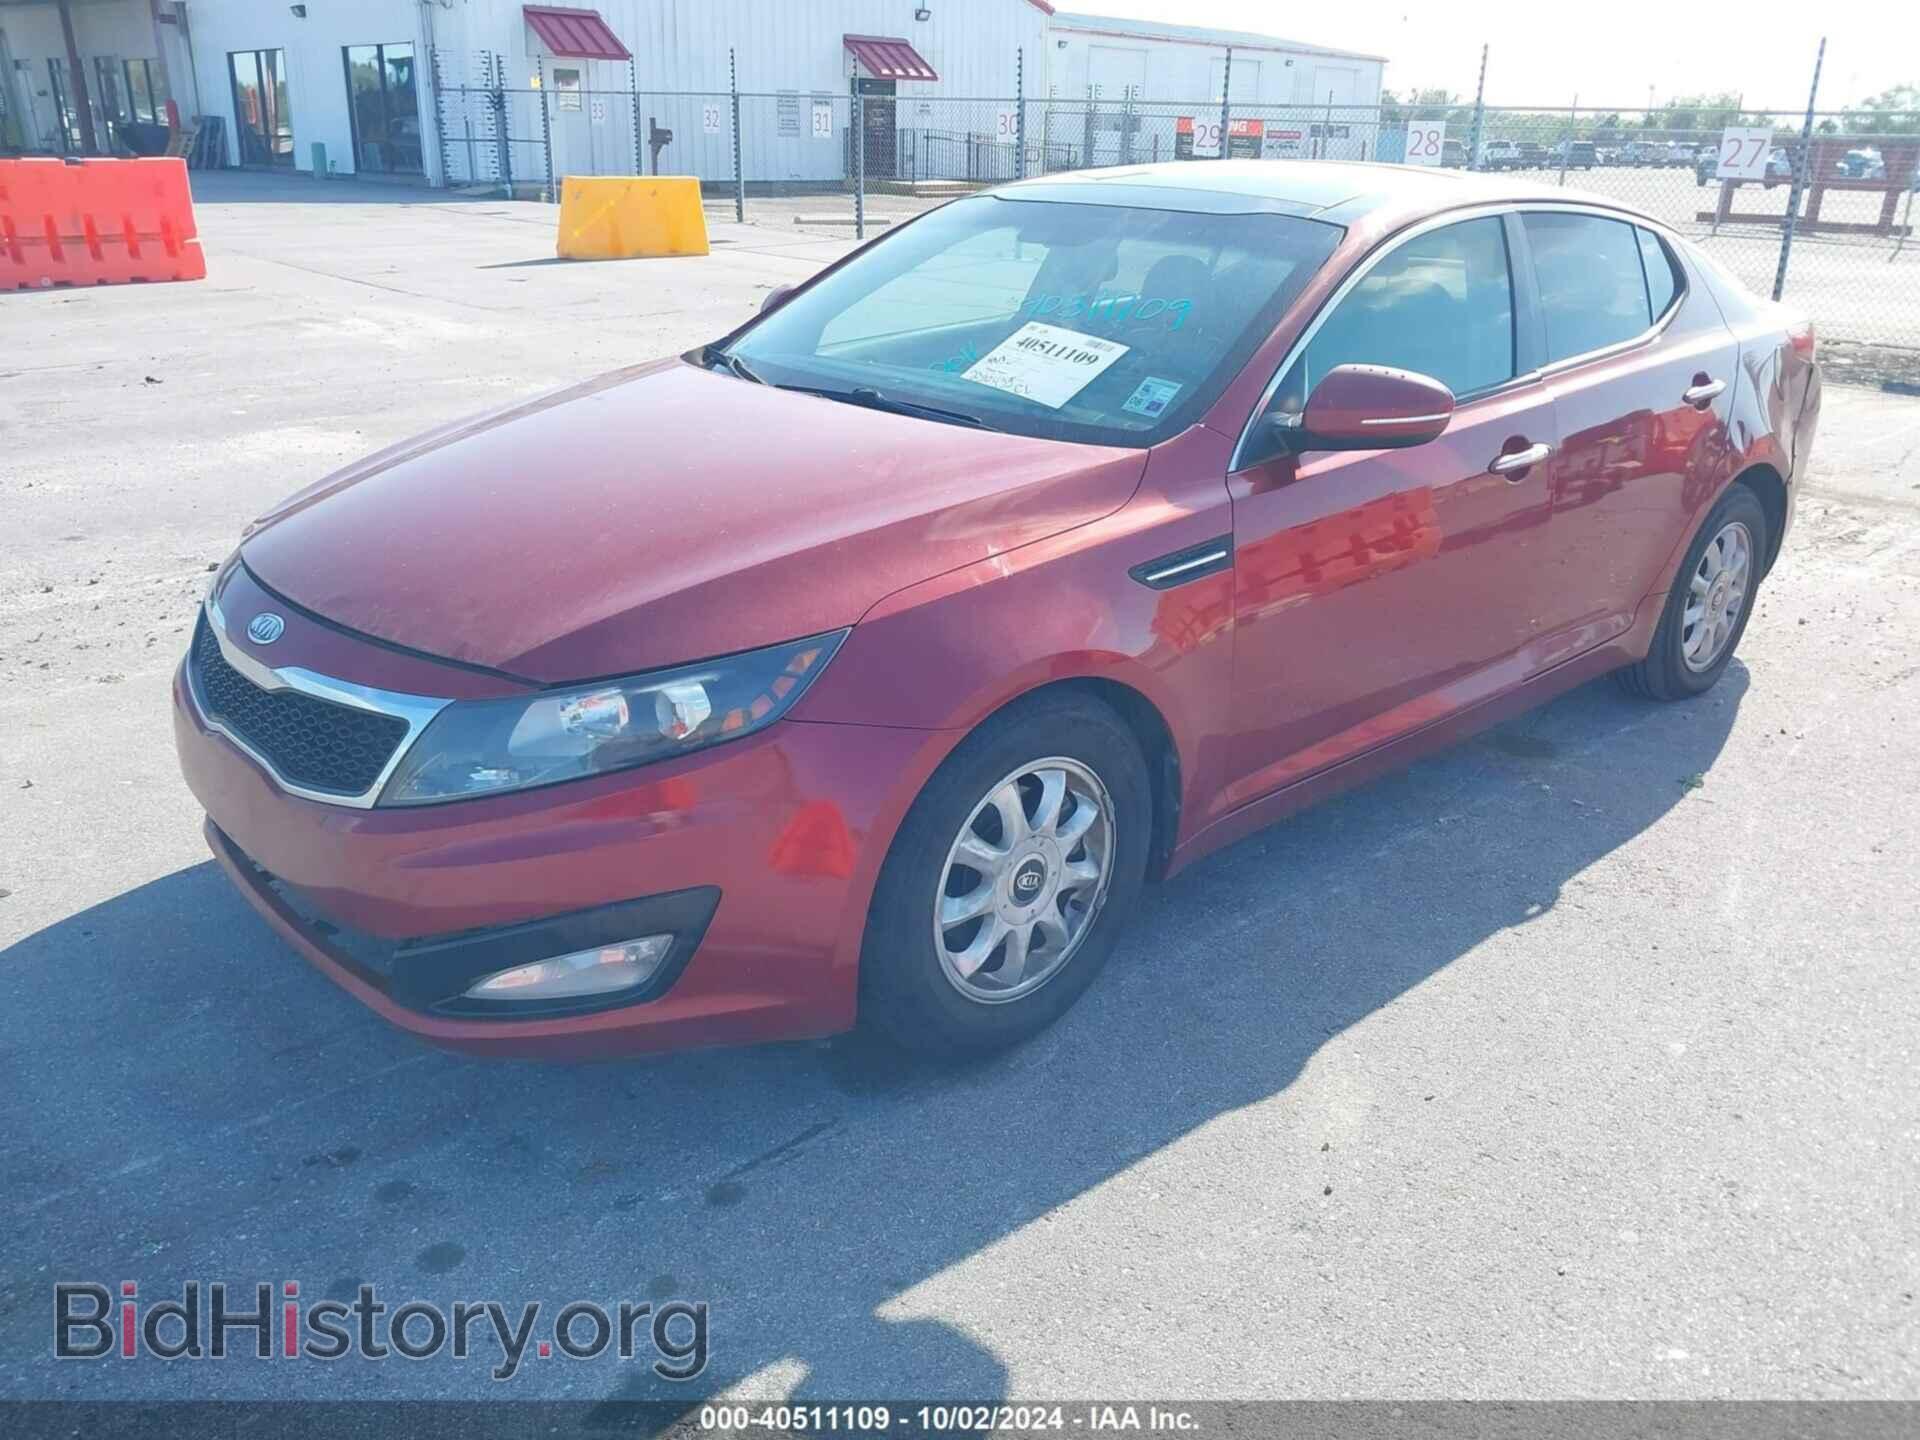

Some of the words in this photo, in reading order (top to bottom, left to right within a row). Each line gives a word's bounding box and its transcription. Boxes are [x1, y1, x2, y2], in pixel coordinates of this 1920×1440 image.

[592, 103, 605, 120] 33
[705, 109, 719, 128] 32
[814, 112, 829, 132] 31
[999, 114, 1019, 135] 30
[1195, 124, 1221, 148] 29
[1408, 129, 1440, 156] 28
[1722, 137, 1767, 168] 27
[1016, 336, 1100, 366] 40511109
